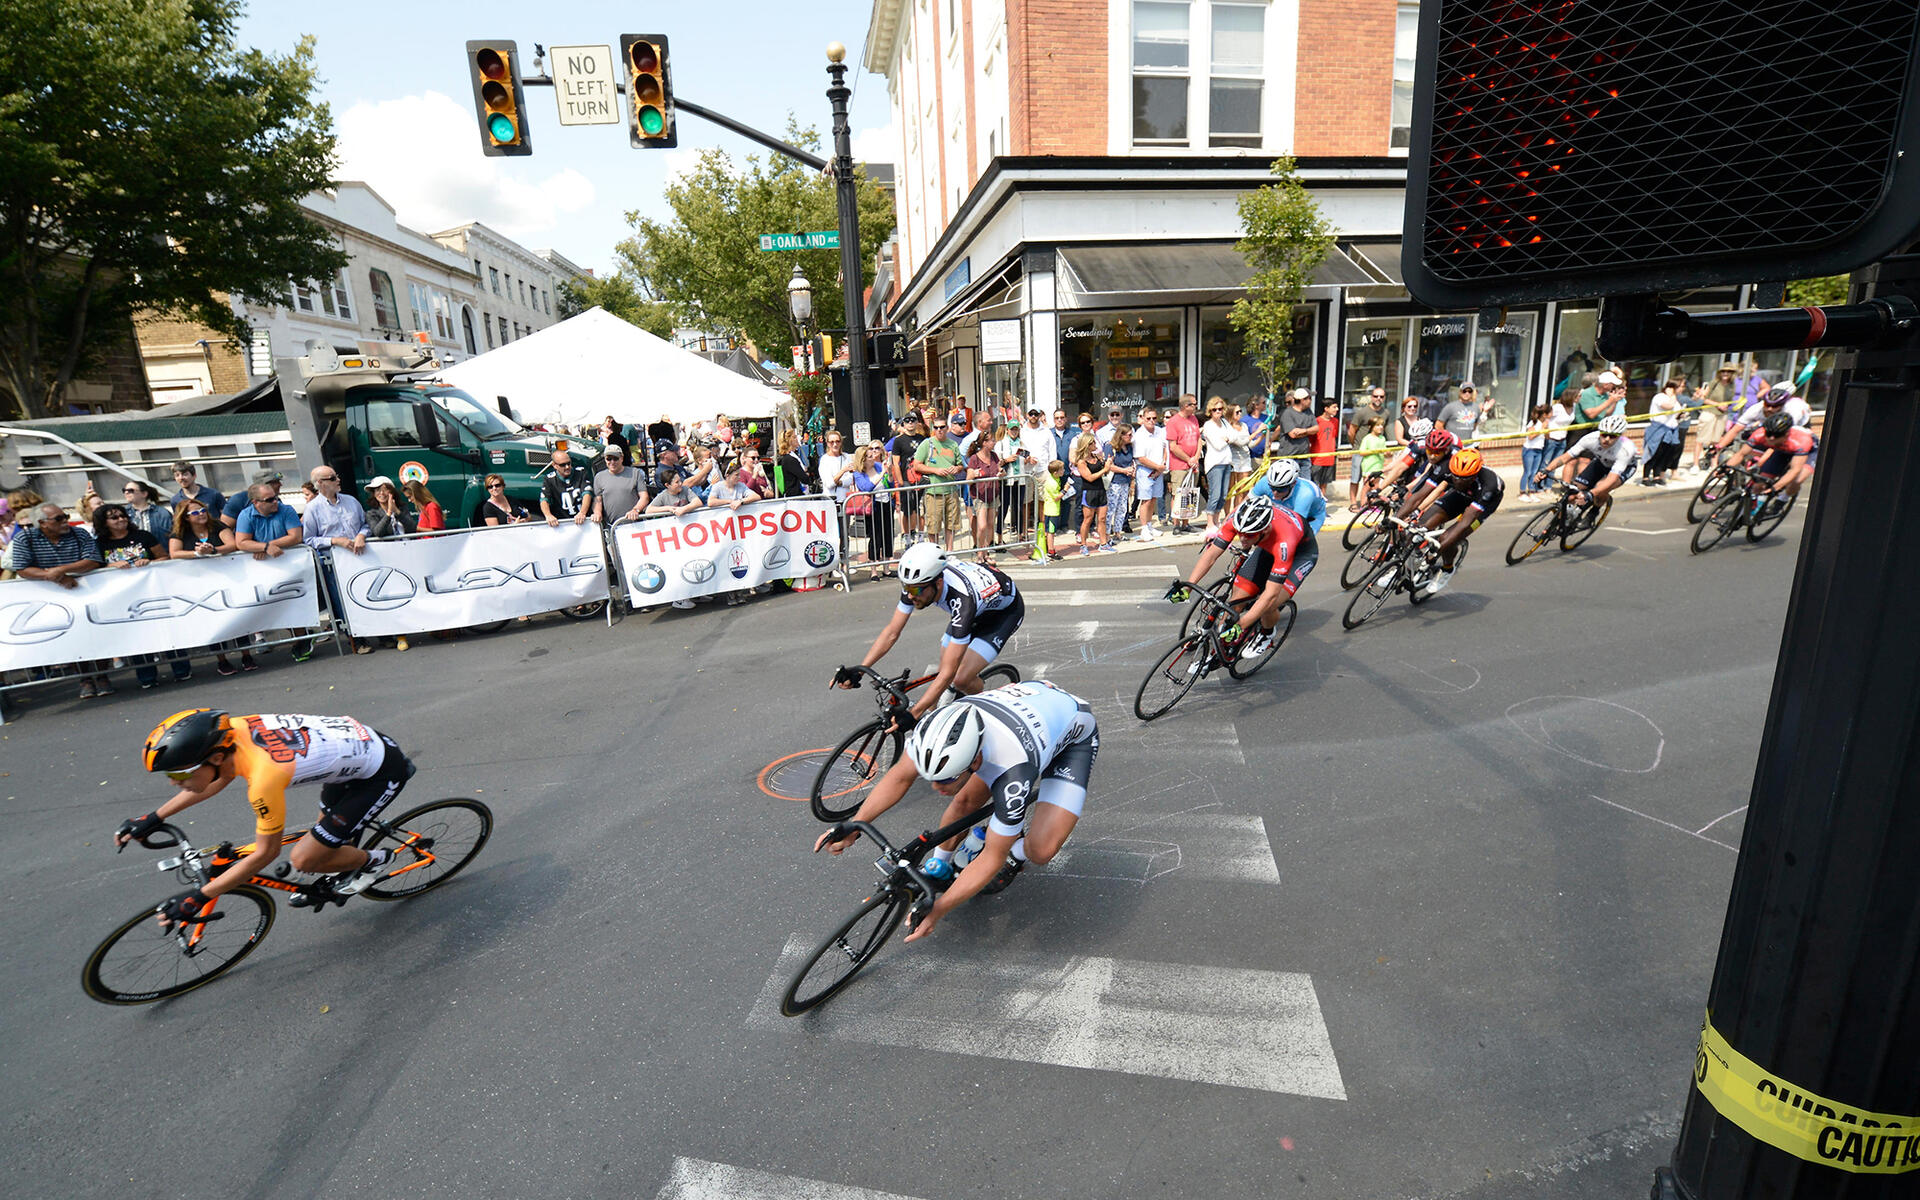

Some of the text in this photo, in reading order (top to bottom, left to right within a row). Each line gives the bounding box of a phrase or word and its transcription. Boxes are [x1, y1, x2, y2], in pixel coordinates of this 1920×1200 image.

[568, 56, 596, 75] NO
[566, 81, 604, 96] LEFT
[566, 101, 609, 116] TURN
[777, 234, 826, 248] OAKLAND
[827, 236, 839, 244] AVE
[1065, 326, 1152, 339] Serendipity Shops
[1361, 327, 1389, 346] A FUN
[1421, 323, 1465, 337] SHOPPING
[631, 510, 827, 555] THOMPSON
[424, 553, 603, 594] LEXUS
[86, 578, 307, 625] LEXUS
[351, 781, 399, 833] TREK
[249, 875, 301, 893] TREK
